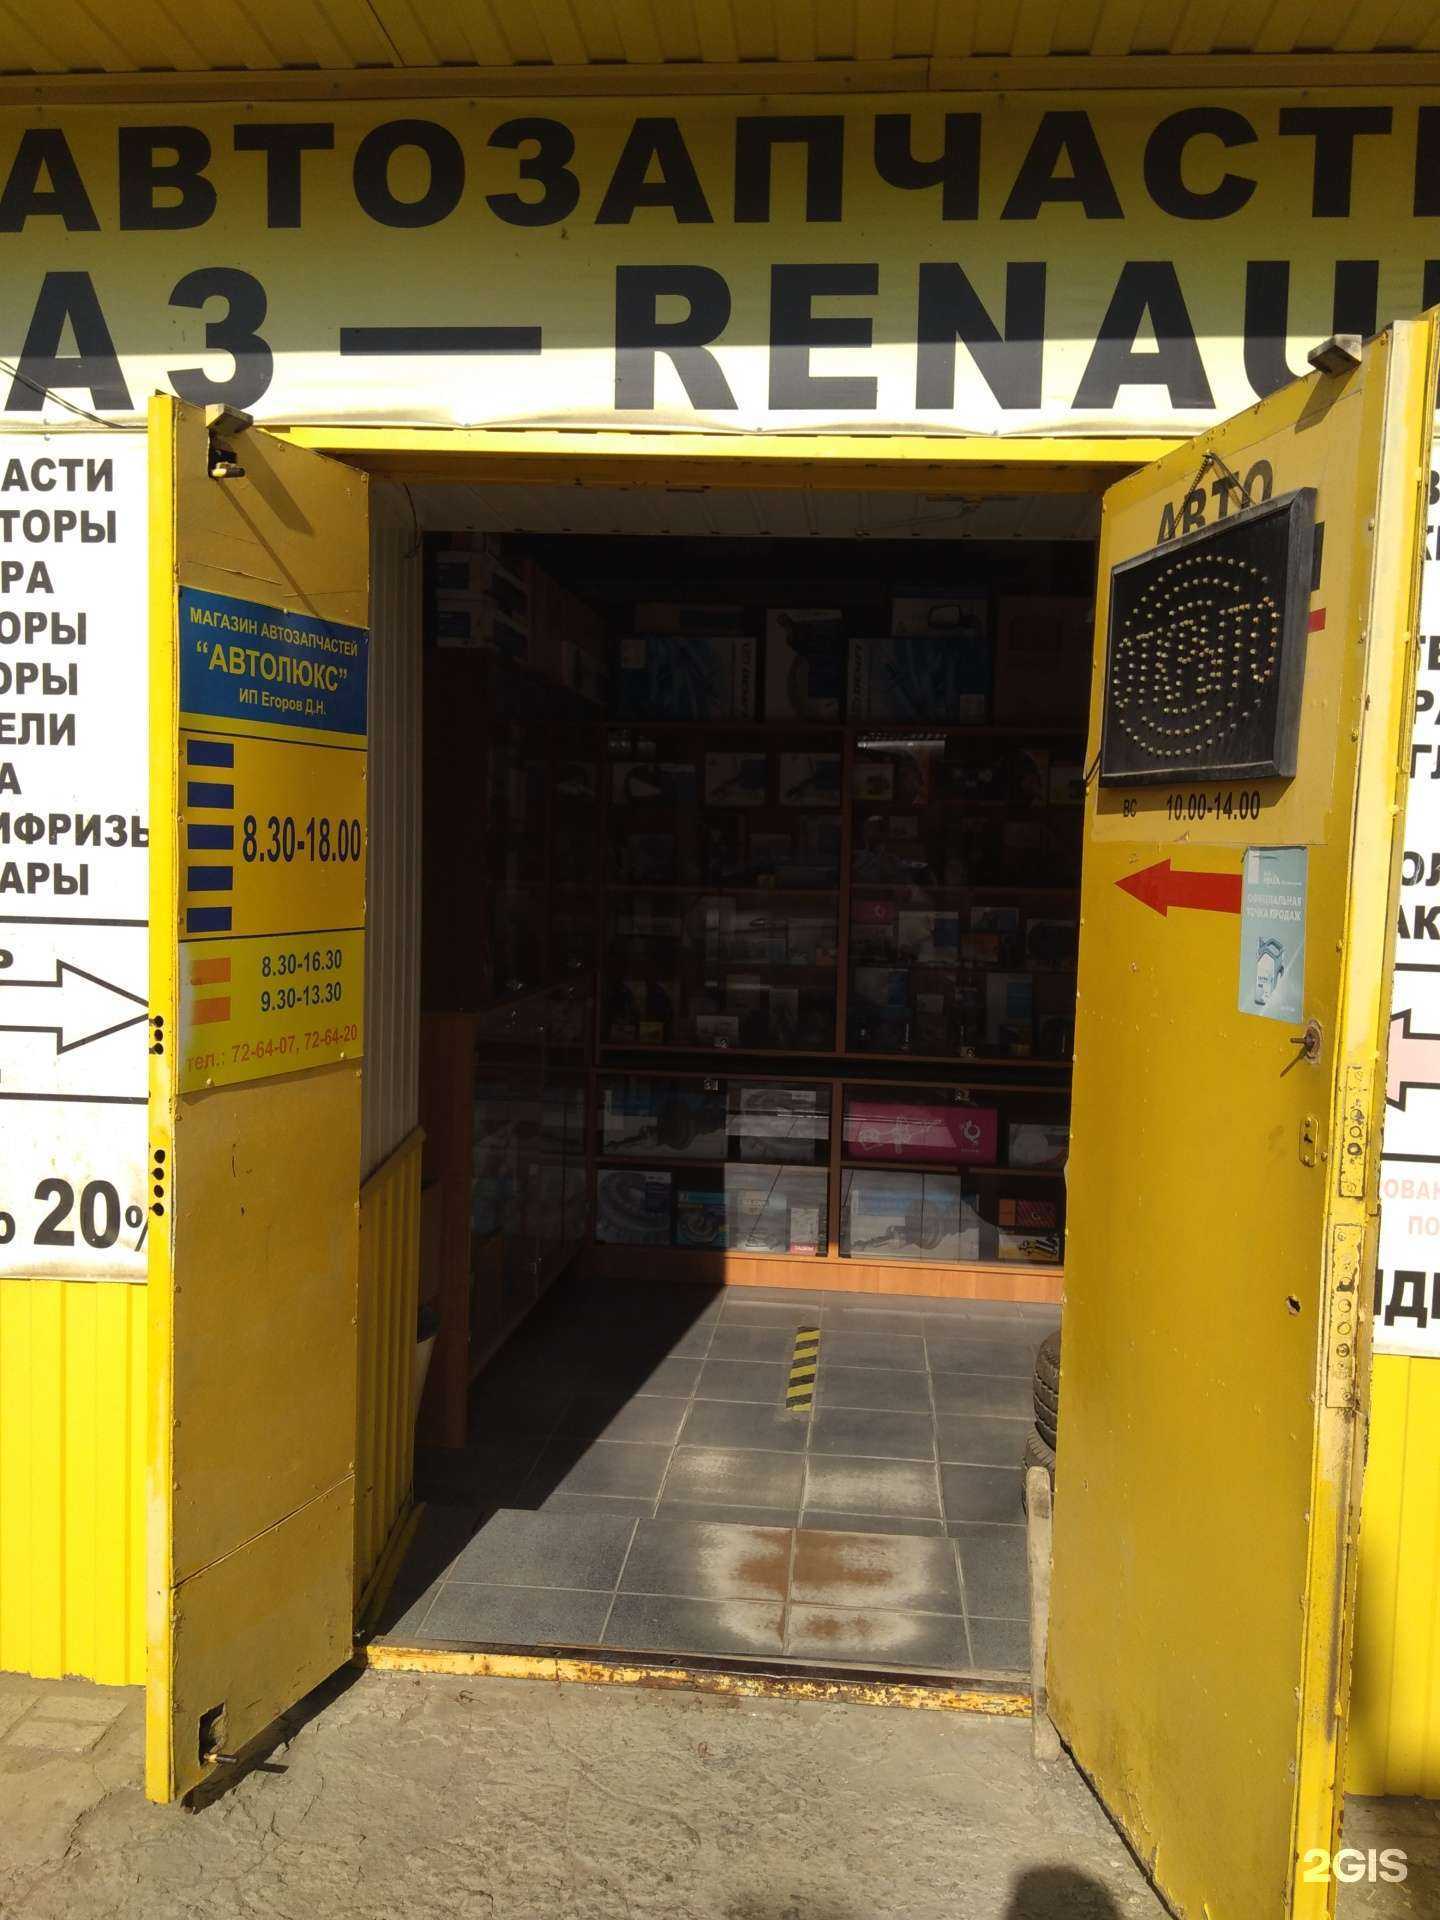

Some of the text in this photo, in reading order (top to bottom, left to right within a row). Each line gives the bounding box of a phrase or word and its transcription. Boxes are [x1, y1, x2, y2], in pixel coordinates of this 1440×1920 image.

[614, 259, 1440, 411] RENAU
[0, 458, 114, 493] АСТИ
[0, 560, 55, 594] РА
[189, 607, 358, 657] МАГАЗИН АВТОЗАПЧАСТЕЙ
[239, 687, 327, 716] ИП Егоров Д.Н.
[1122, 790, 1261, 821] ВС 10.00-14.00
[241, 814, 362, 863] 8.30-18.00
[261, 948, 343, 978] 8.30-16.30
[260, 981, 343, 1013] 9.30-13.30
[231, 1034, 300, 1064] 72-64-07,
[303, 1023, 359, 1051] 72-64-20
